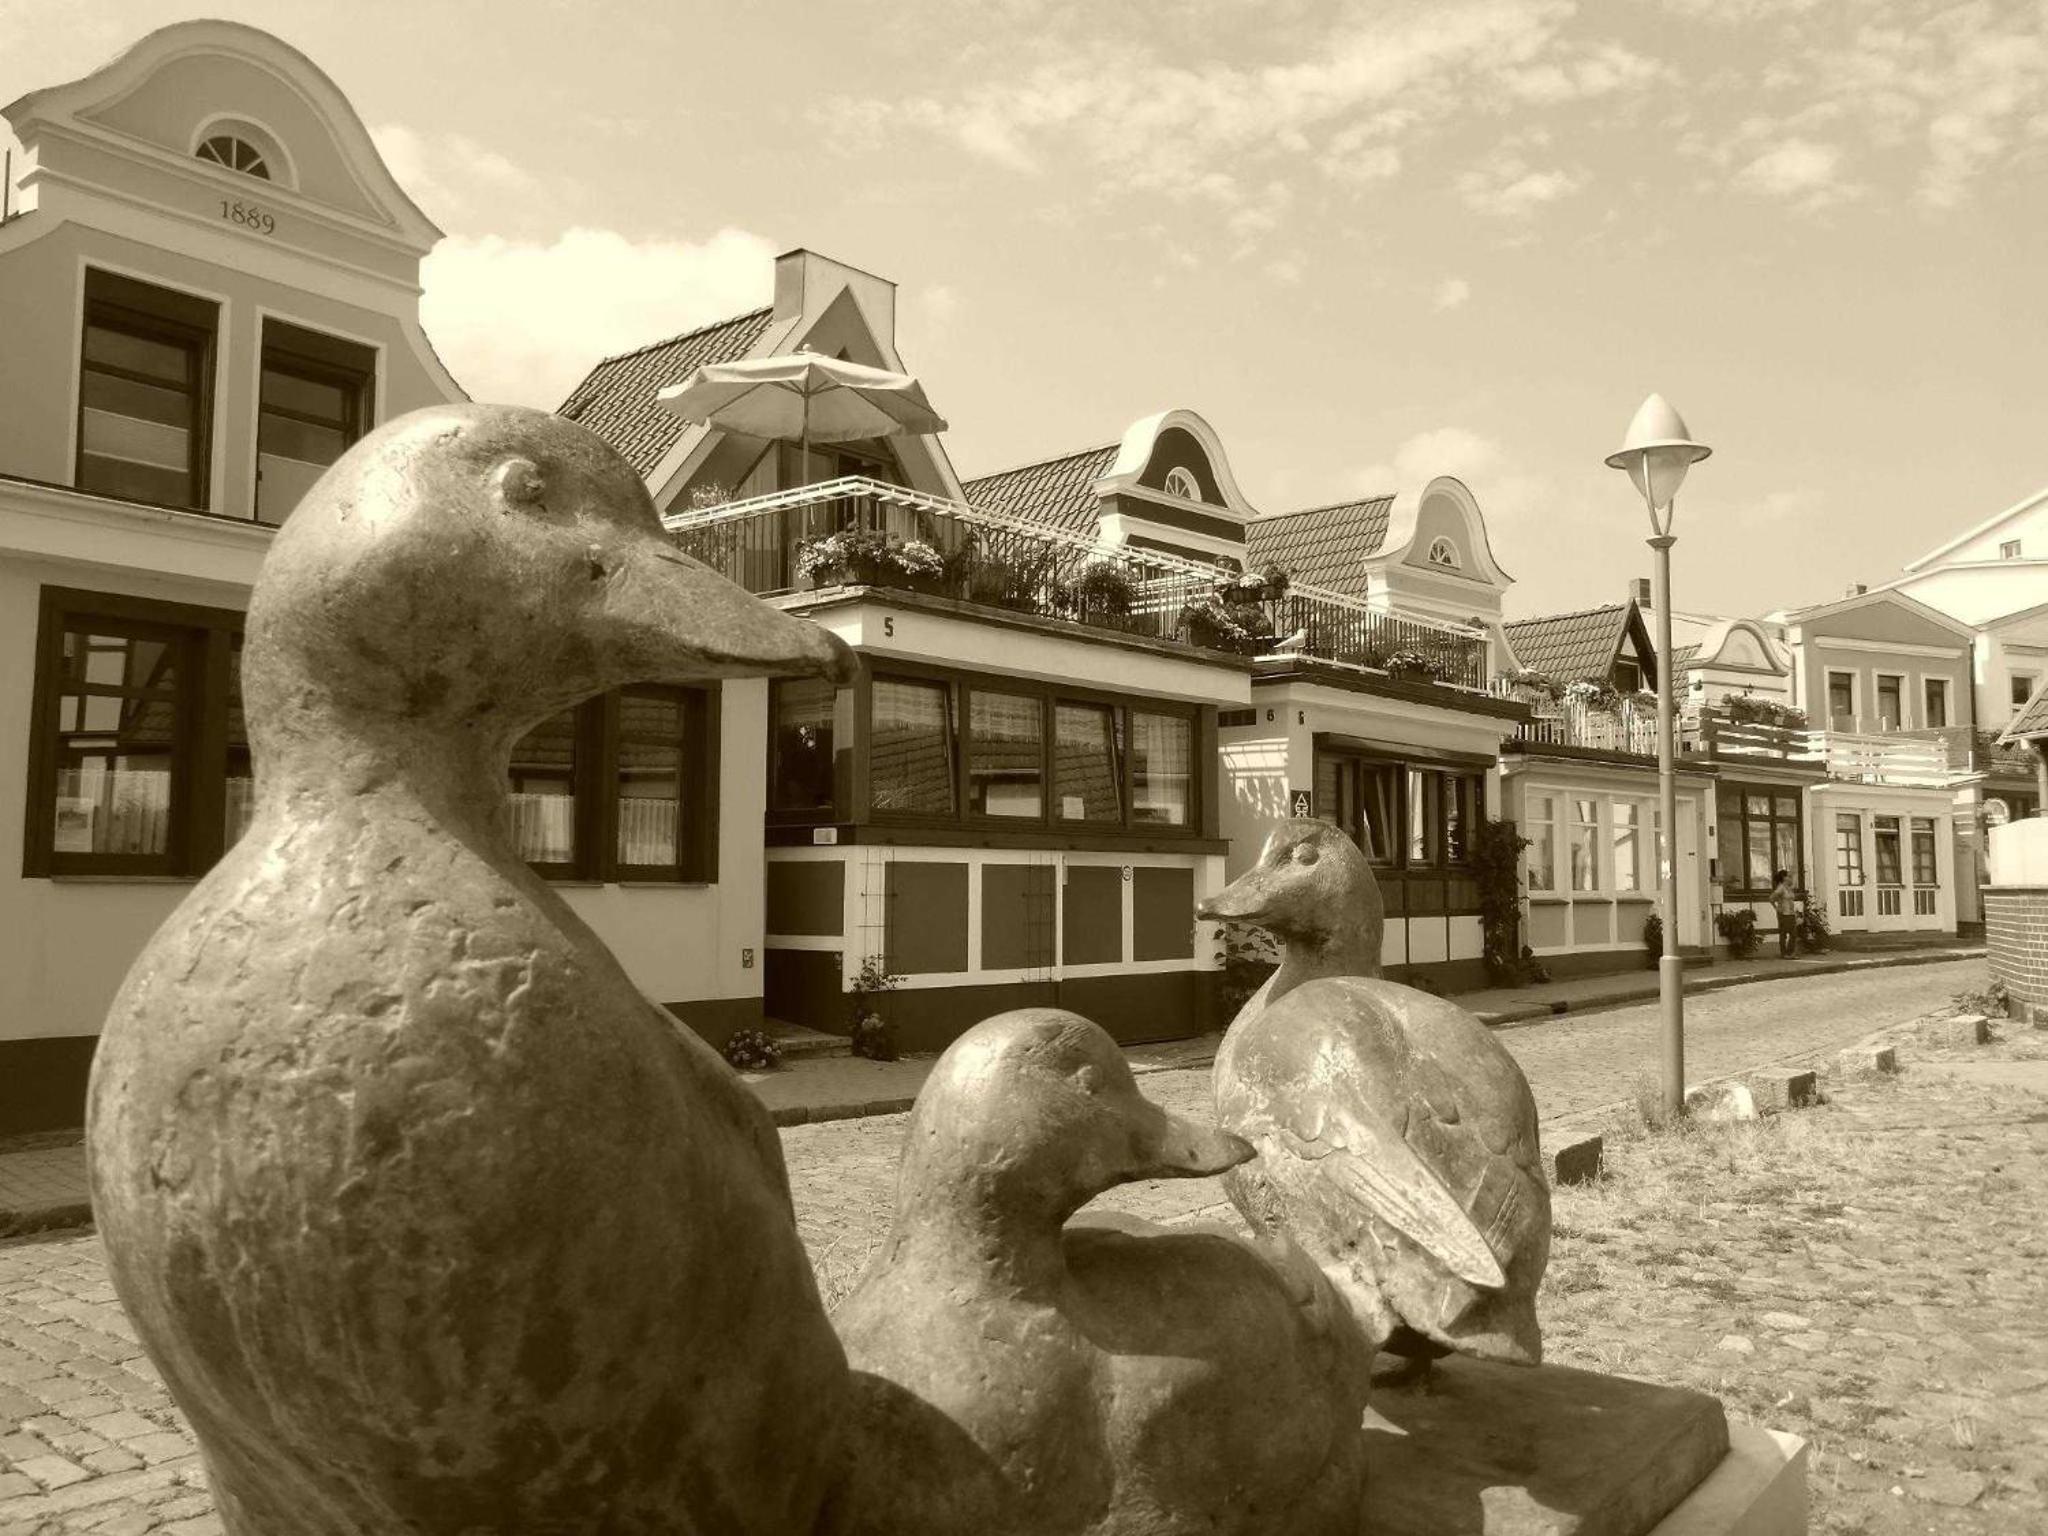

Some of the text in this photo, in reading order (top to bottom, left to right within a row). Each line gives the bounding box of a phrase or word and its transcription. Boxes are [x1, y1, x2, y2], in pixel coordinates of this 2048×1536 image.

[220, 200, 275, 235] 1889
[884, 616, 894, 637] 5
[1266, 709, 1275, 722] 6
